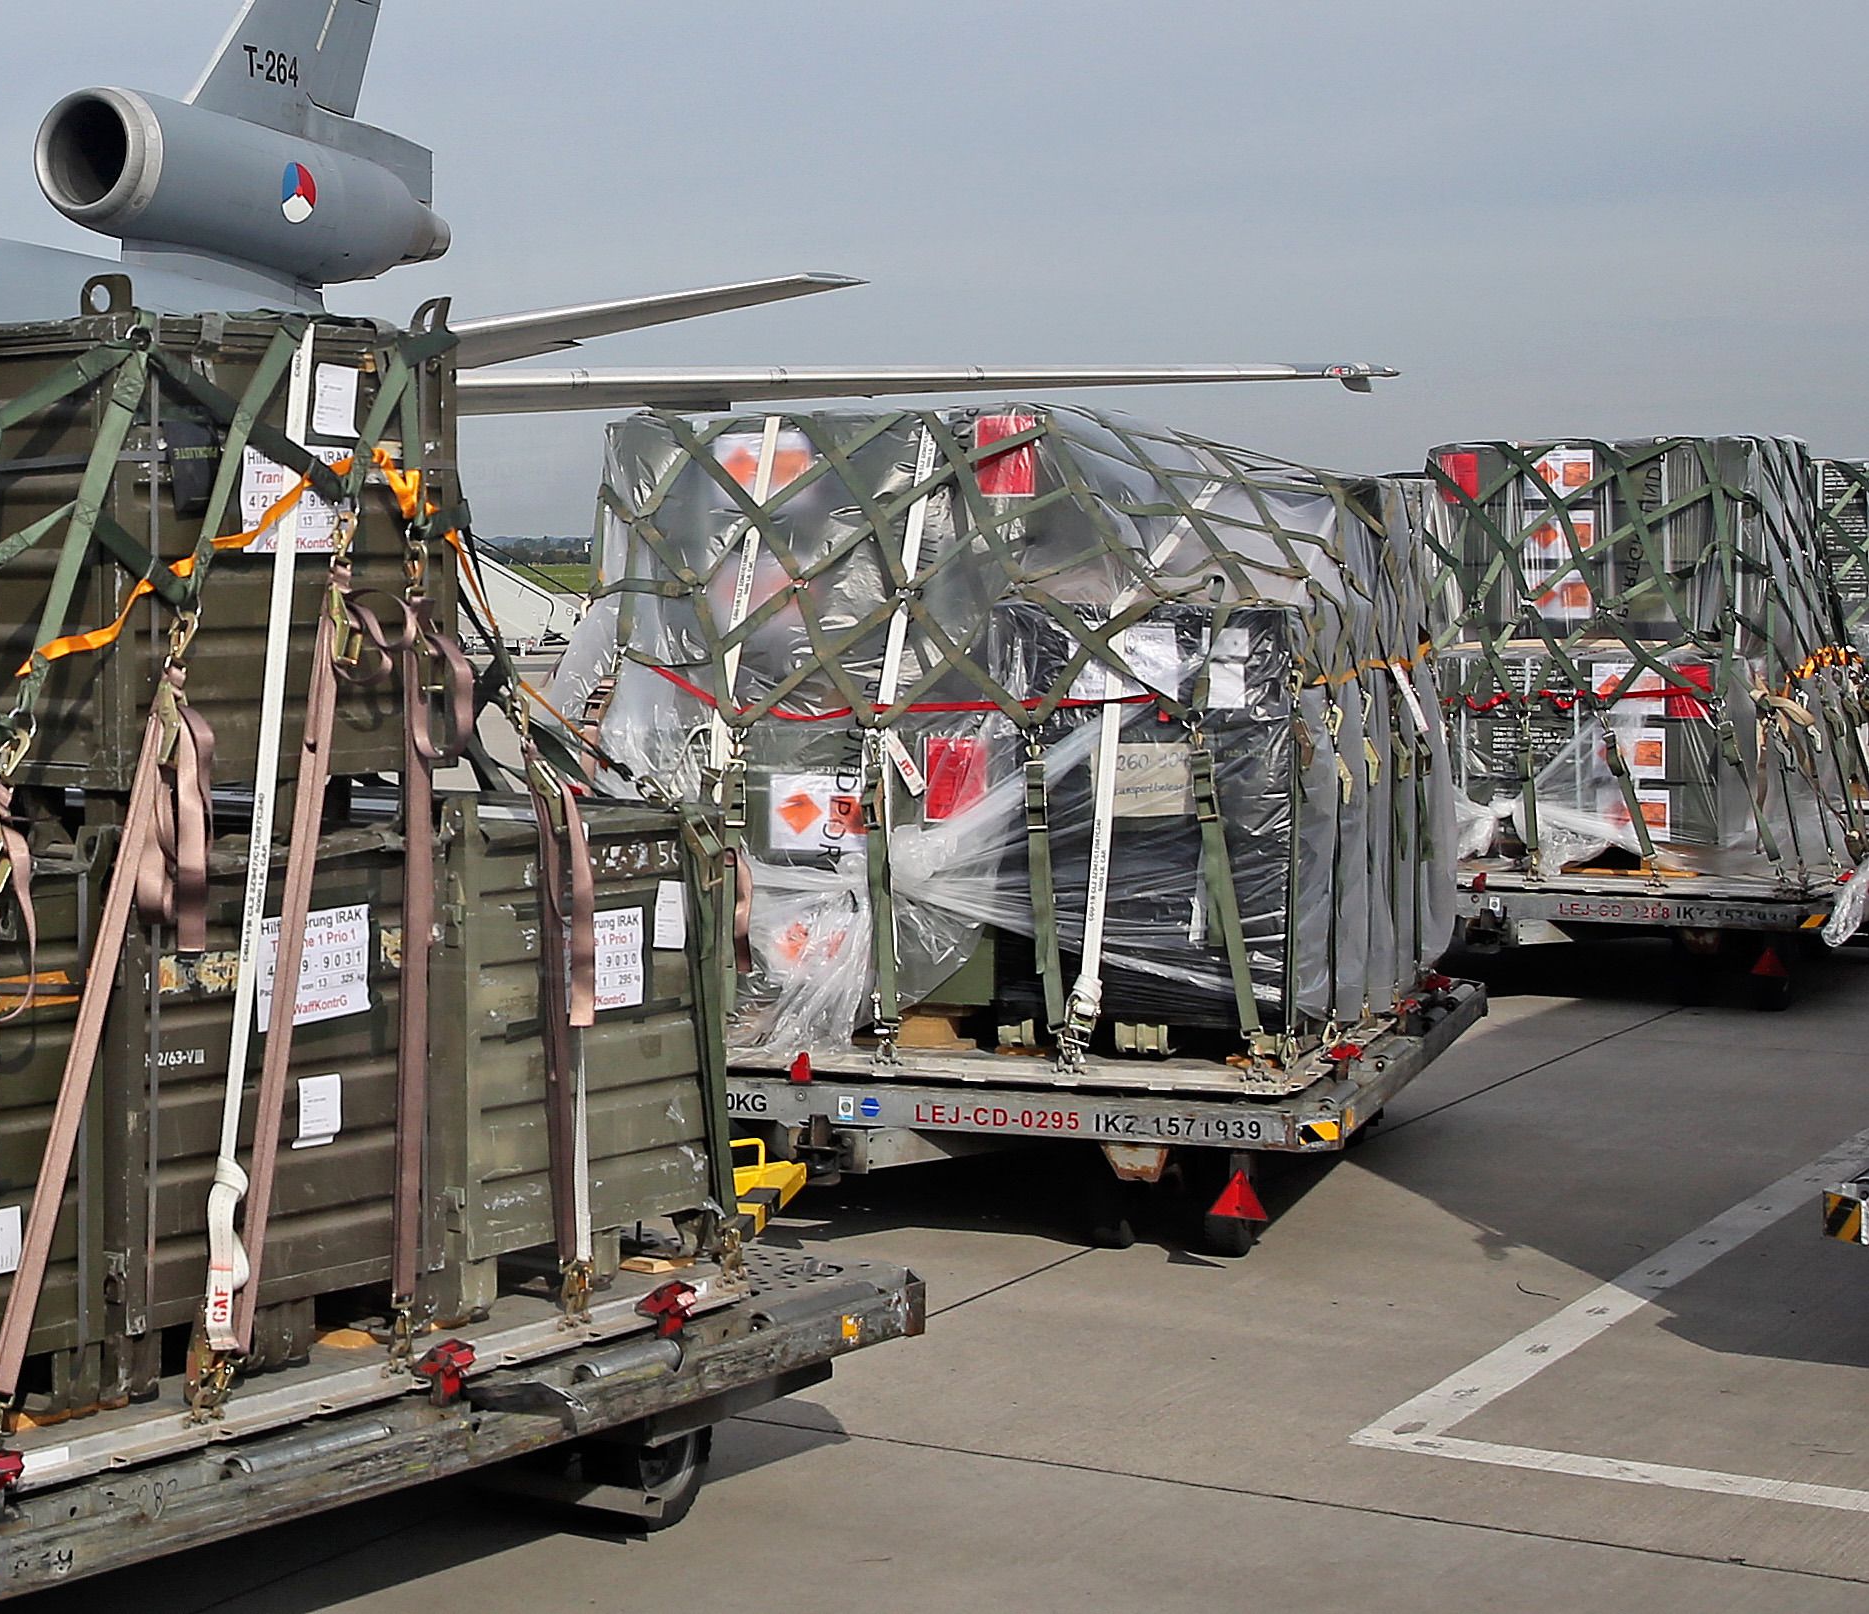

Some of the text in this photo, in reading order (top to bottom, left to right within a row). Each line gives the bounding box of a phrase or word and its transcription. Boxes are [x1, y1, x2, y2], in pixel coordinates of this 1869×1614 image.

[243, 44, 298, 88] T-264
[335, 908, 363, 923] IRAK
[617, 914, 639, 927] IRAK
[326, 930, 348, 945] Prio
[609, 933, 627, 945] Prio
[293, 994, 348, 1015] WaffKontrG
[727, 1092, 768, 1113] 0KG
[915, 1103, 1079, 1131] LEJ-CD-0295
